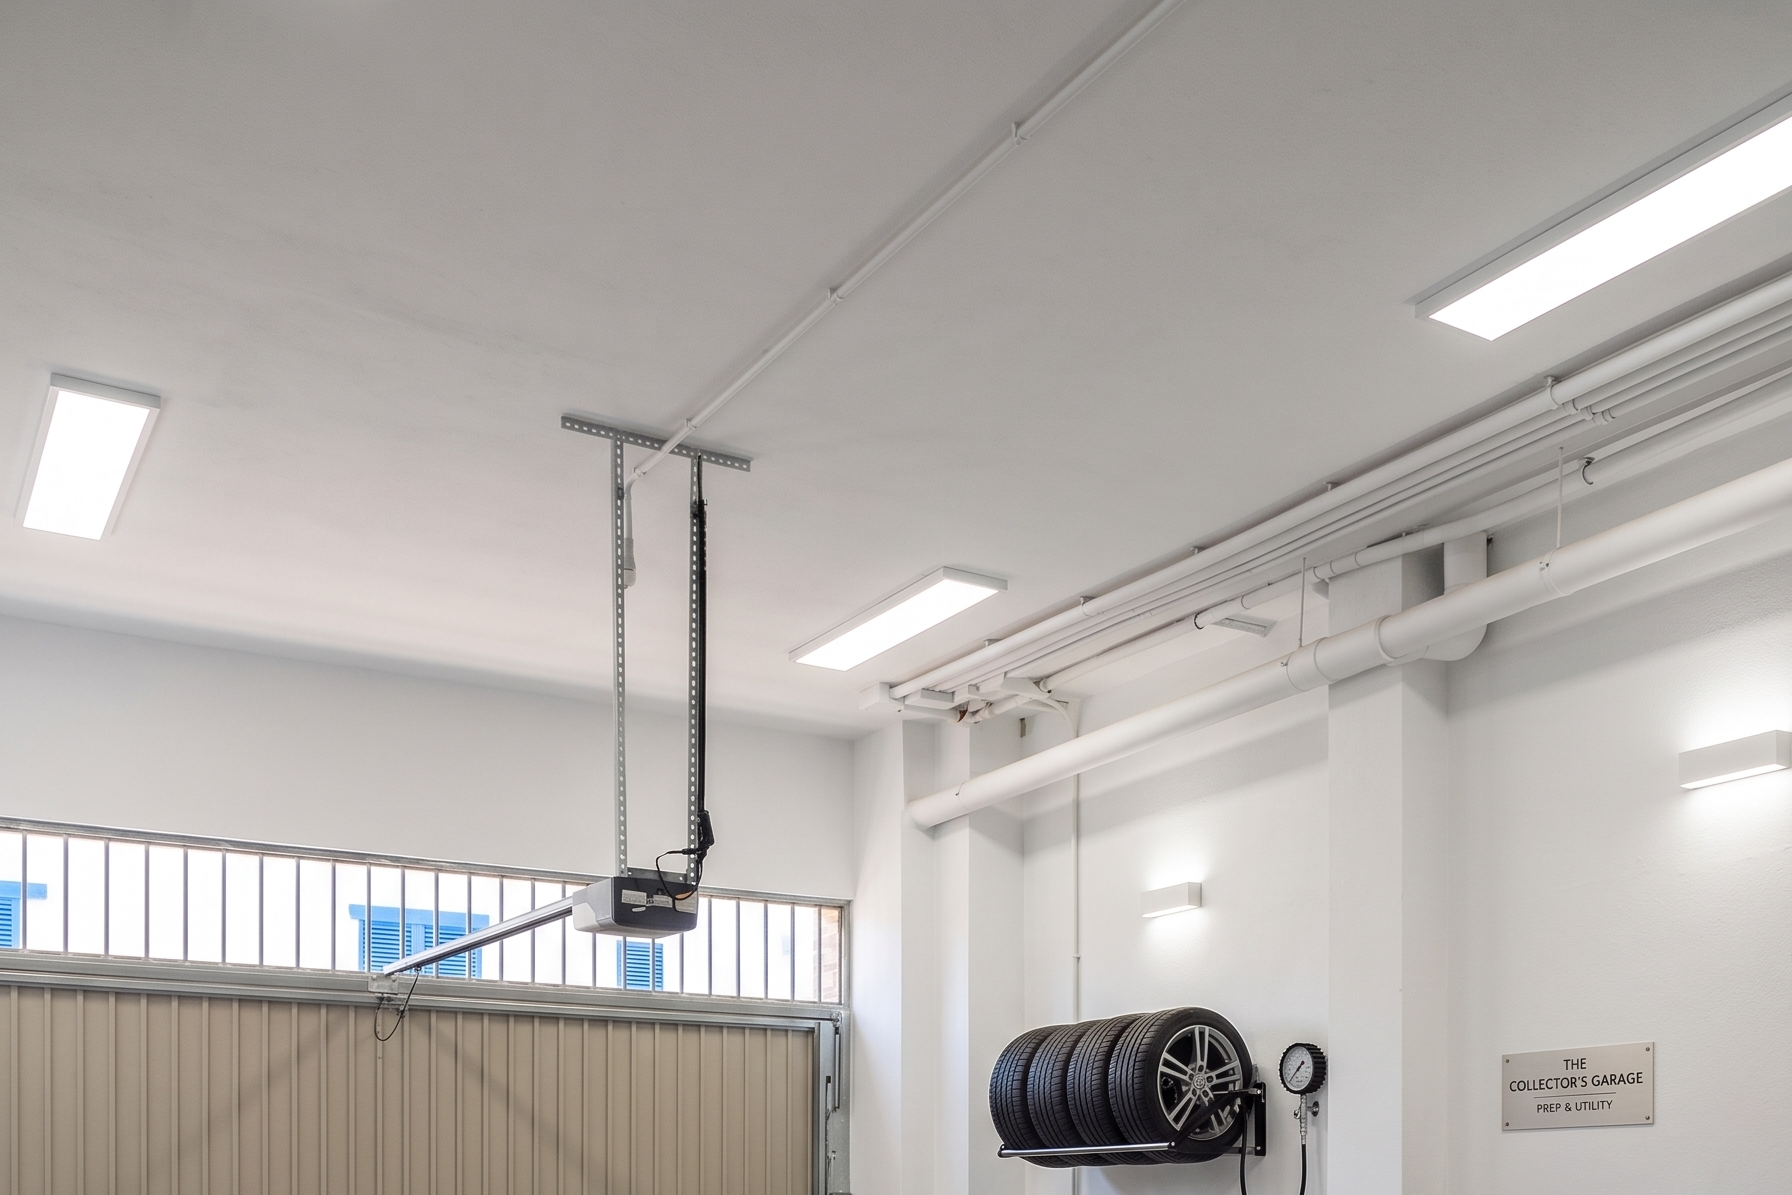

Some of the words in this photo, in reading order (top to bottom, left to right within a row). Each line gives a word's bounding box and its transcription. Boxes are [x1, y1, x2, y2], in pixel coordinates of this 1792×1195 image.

[1563, 1058, 1587, 1071] THE
[1509, 1075, 1588, 1092] COLLECTOR'S
[1591, 1071, 1644, 1087] GARAGE
[1536, 1102, 1562, 1113] PREP
[1564, 1102, 1572, 1112] &
[1575, 1100, 1613, 1111] UTILITY
